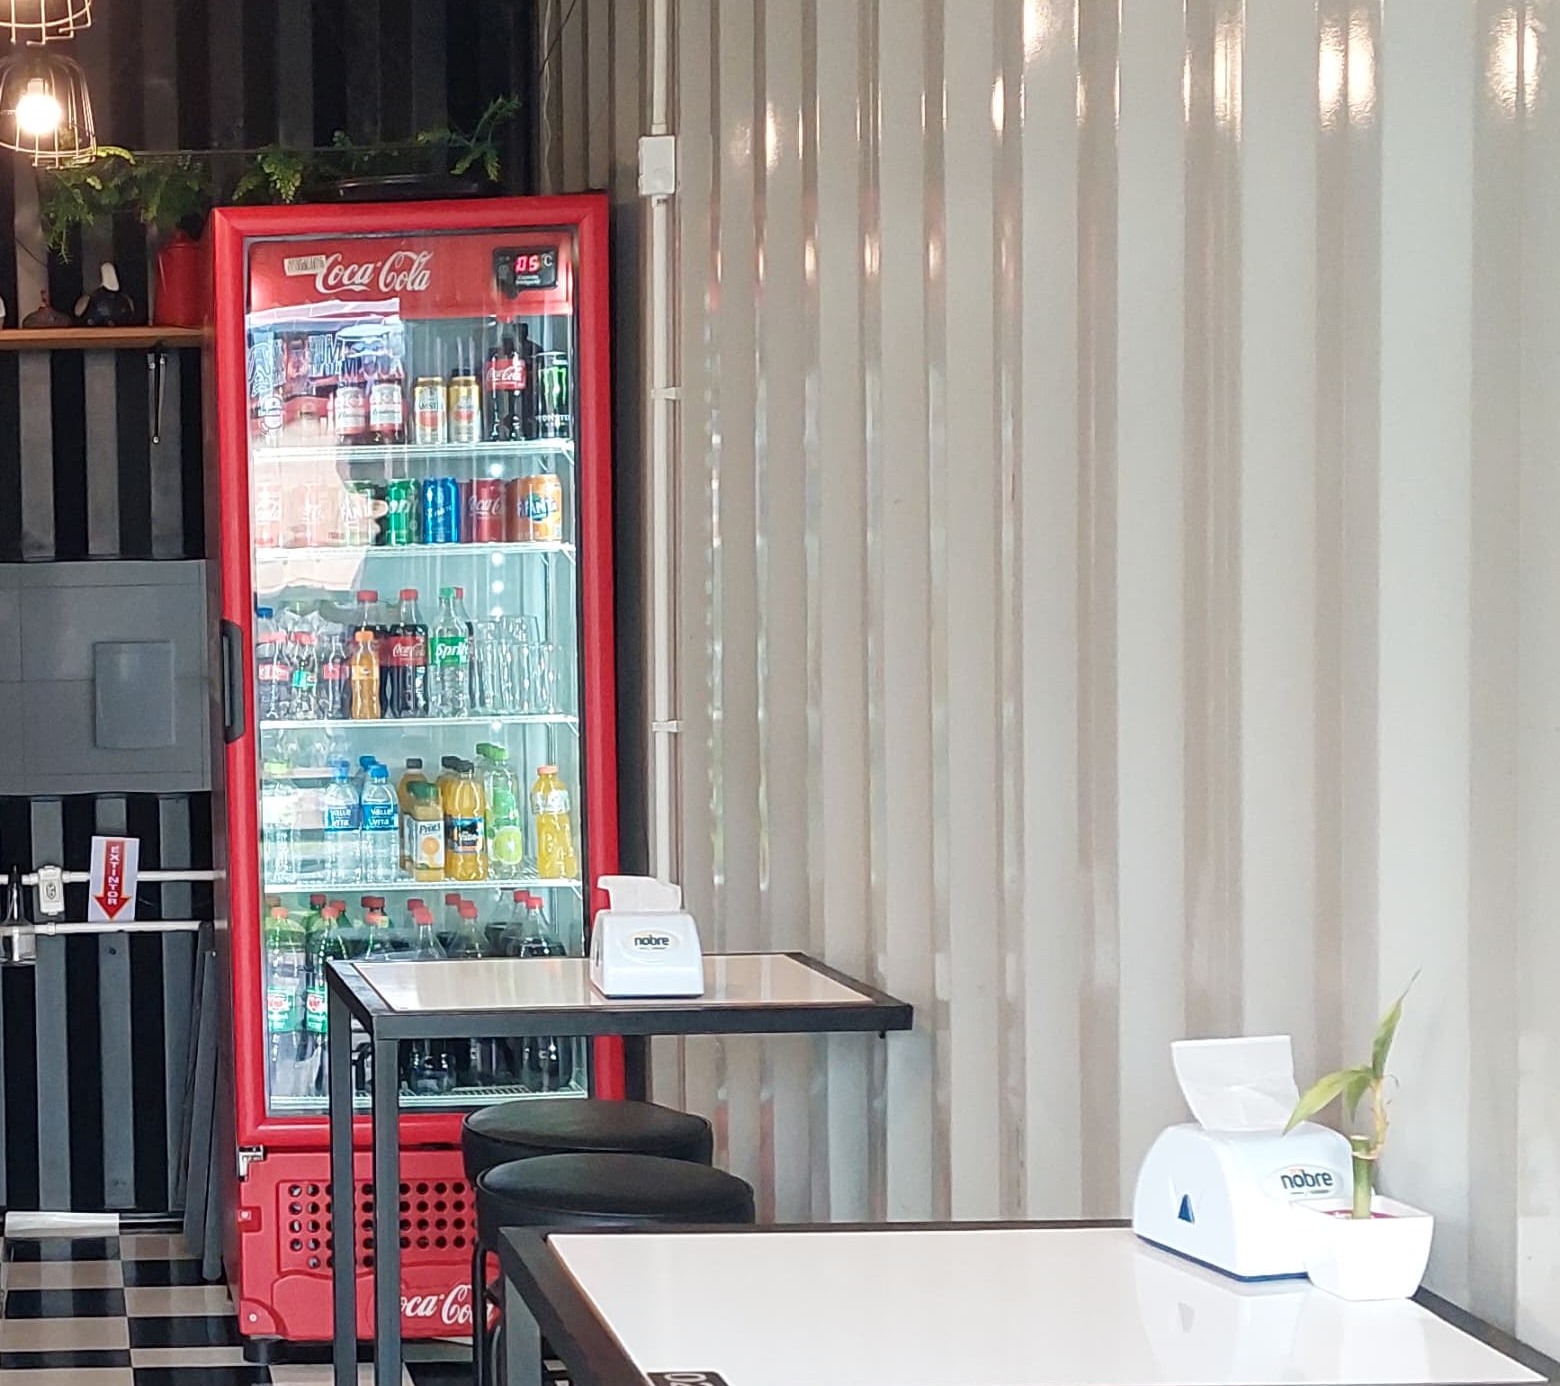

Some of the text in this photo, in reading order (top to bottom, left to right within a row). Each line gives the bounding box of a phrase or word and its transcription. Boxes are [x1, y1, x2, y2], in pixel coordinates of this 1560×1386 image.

[107, 845, 121, 906] EXTINTOR
[634, 934, 670, 947] nobre
[1280, 1168, 1334, 1190] nobre
